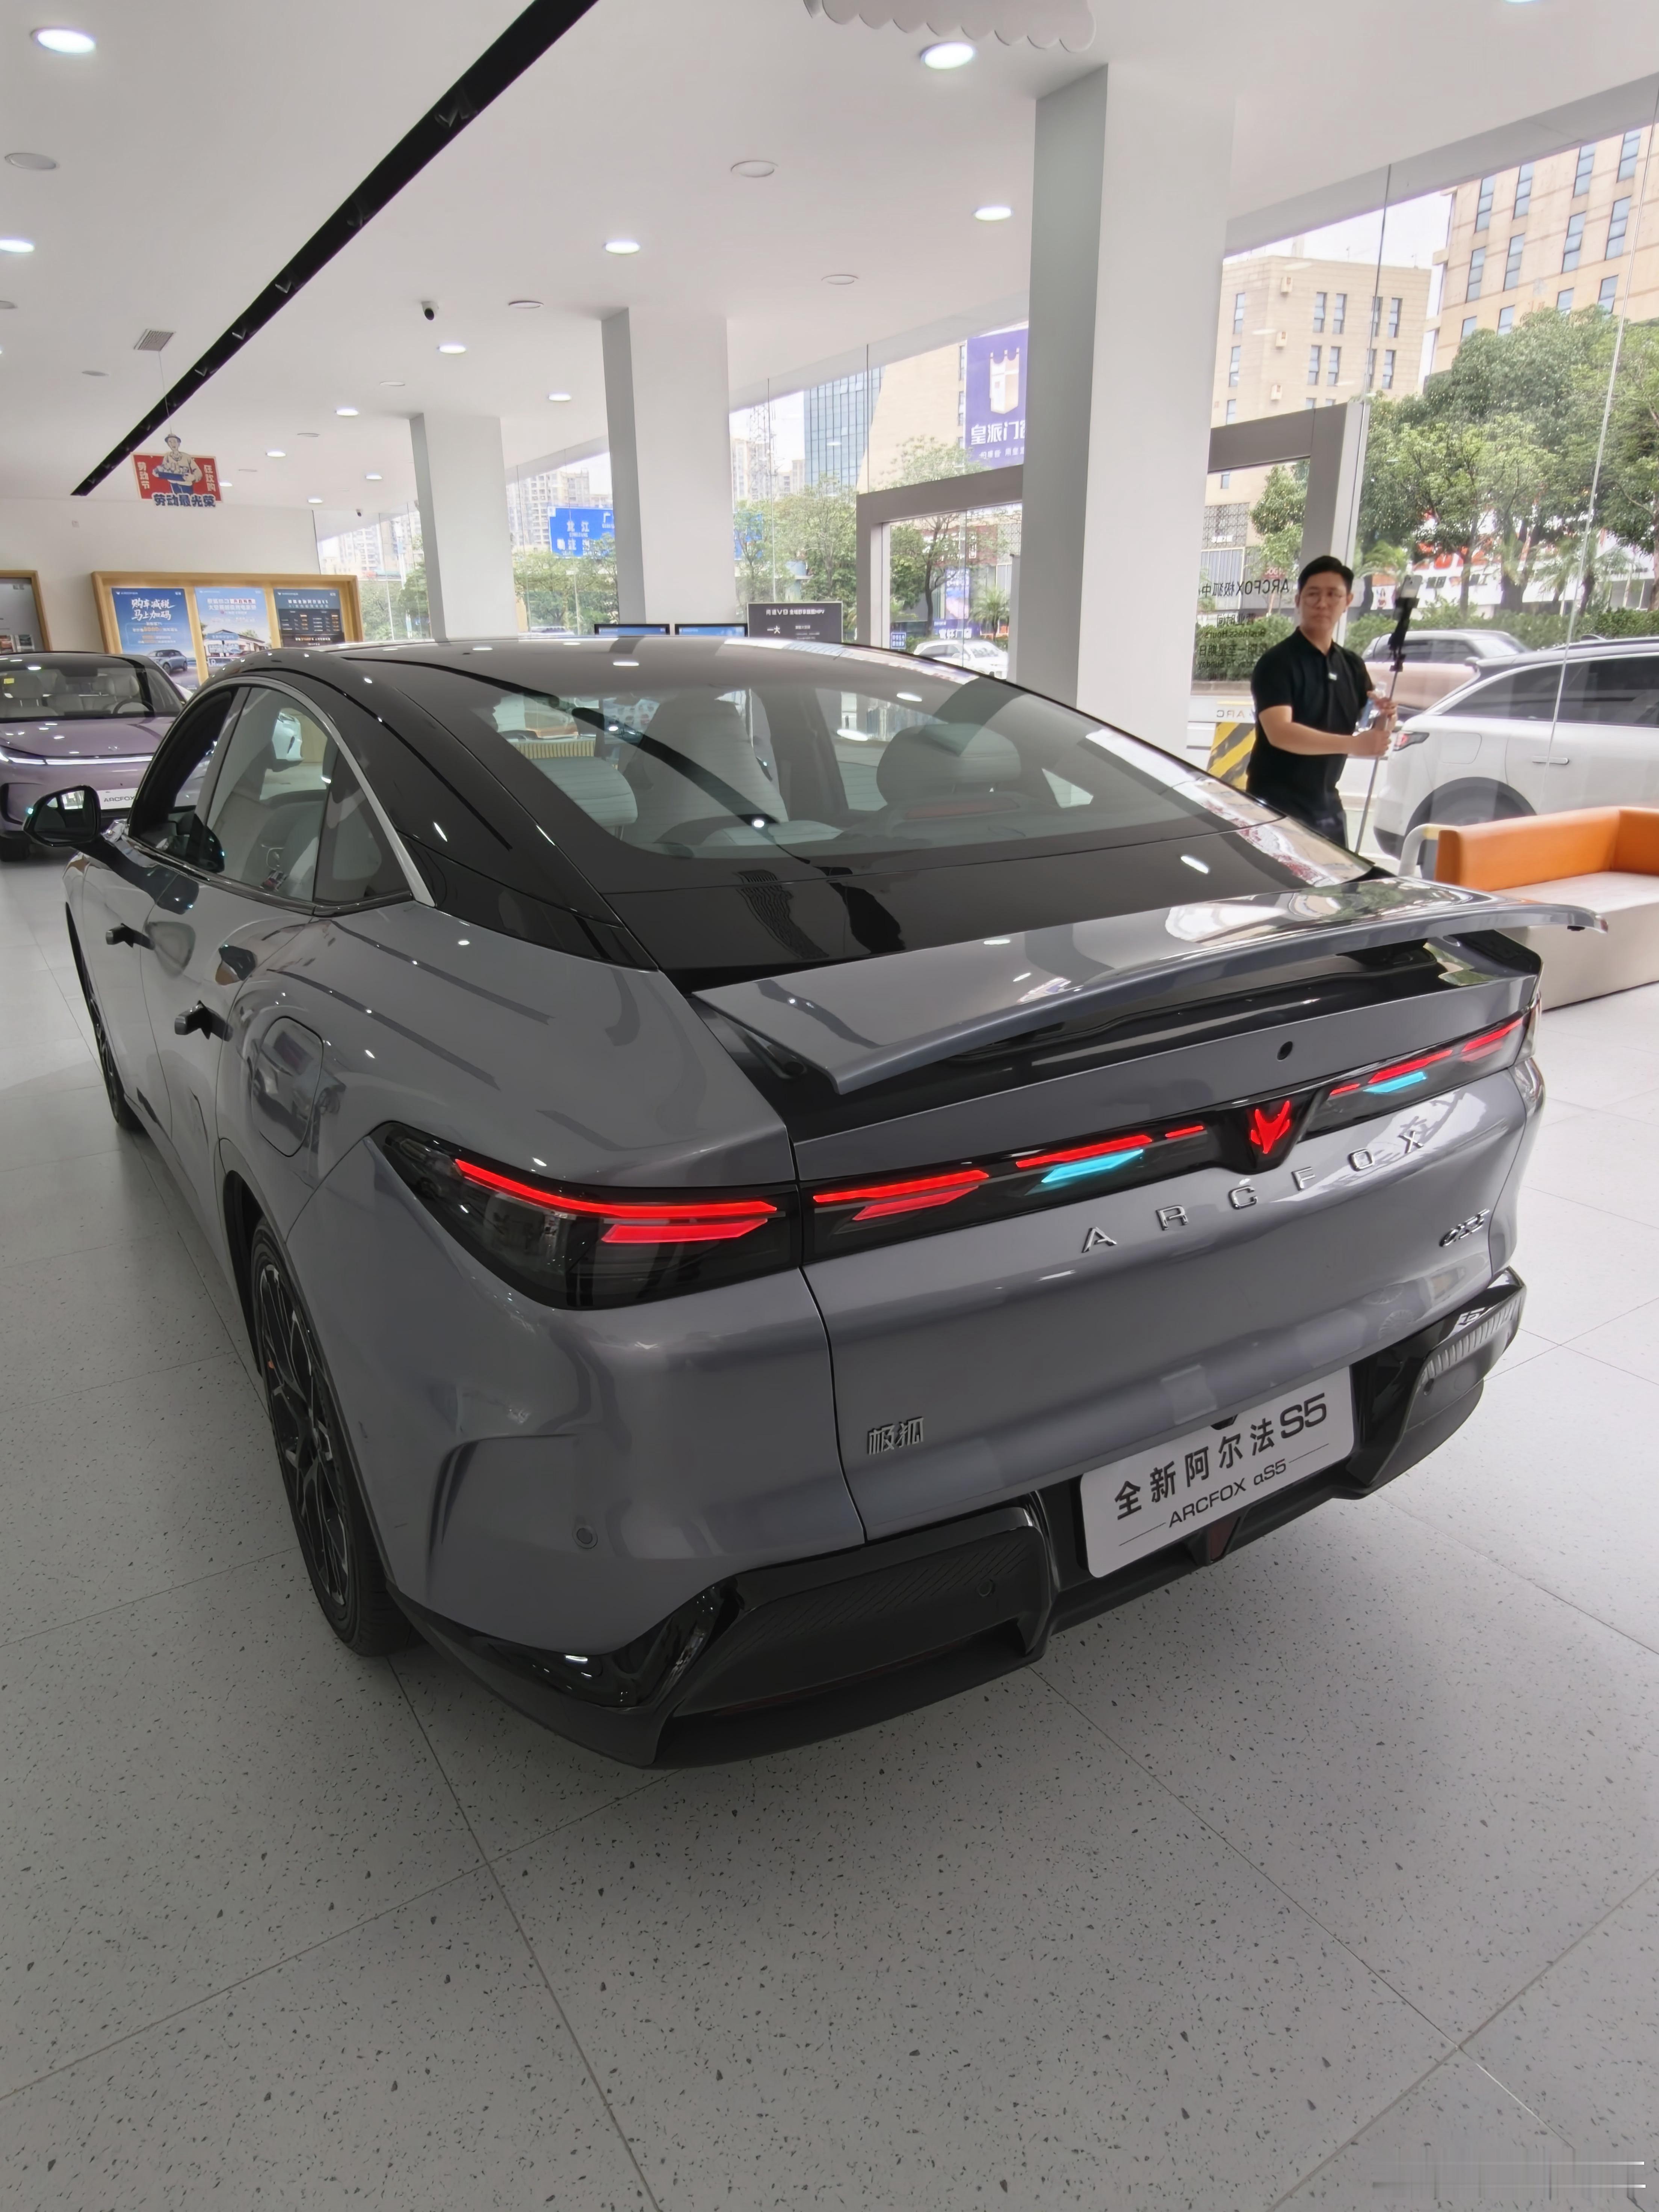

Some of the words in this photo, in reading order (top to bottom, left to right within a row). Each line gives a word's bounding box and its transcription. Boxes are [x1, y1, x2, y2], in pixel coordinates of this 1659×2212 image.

[153, 493, 216, 507] 劳动最光荣
[131, 598, 176, 610] 购车减税
[132, 609, 171, 621] 马上加码
[1082, 1130, 1423, 1253] ARCFOX
[867, 1416, 924, 1455] 极狐
[1169, 1478, 1247, 1528] ARCFOX
